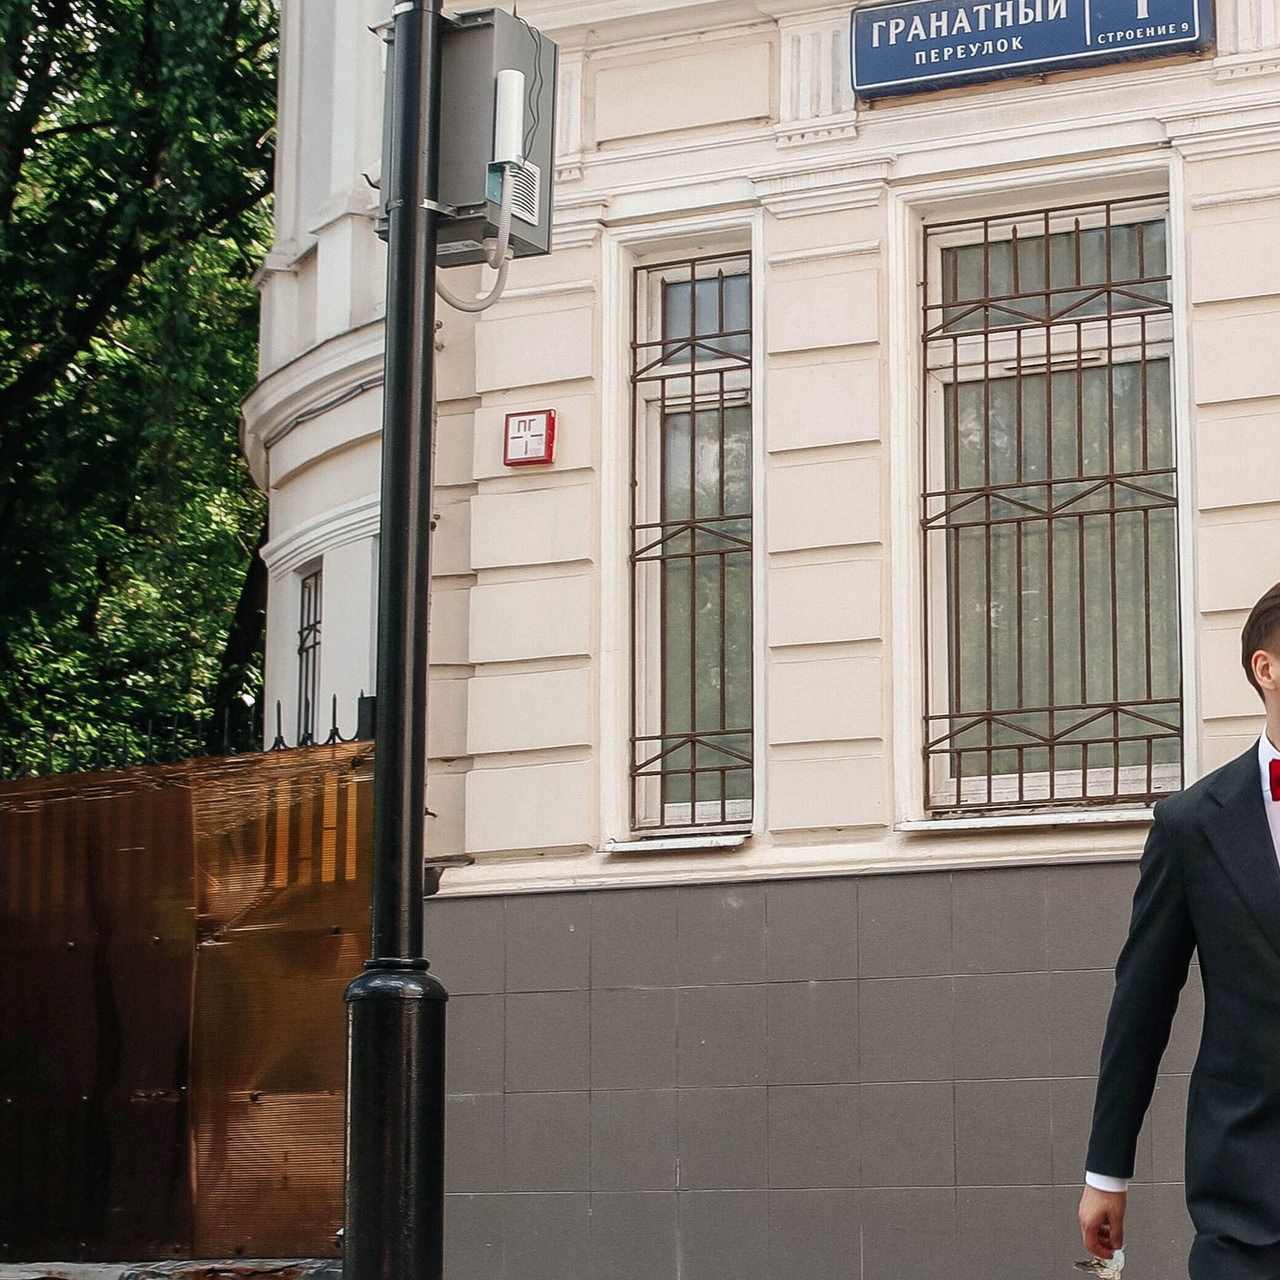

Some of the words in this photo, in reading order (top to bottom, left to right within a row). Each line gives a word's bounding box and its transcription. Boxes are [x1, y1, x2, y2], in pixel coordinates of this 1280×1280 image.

[1097, 23, 1176, 44] СТРОЕНИЕ
[1181, 22, 1189, 32] 9
[914, 36, 1024, 65] ПЕРЕУЛОК
[517, 419, 537, 433] ПГ
